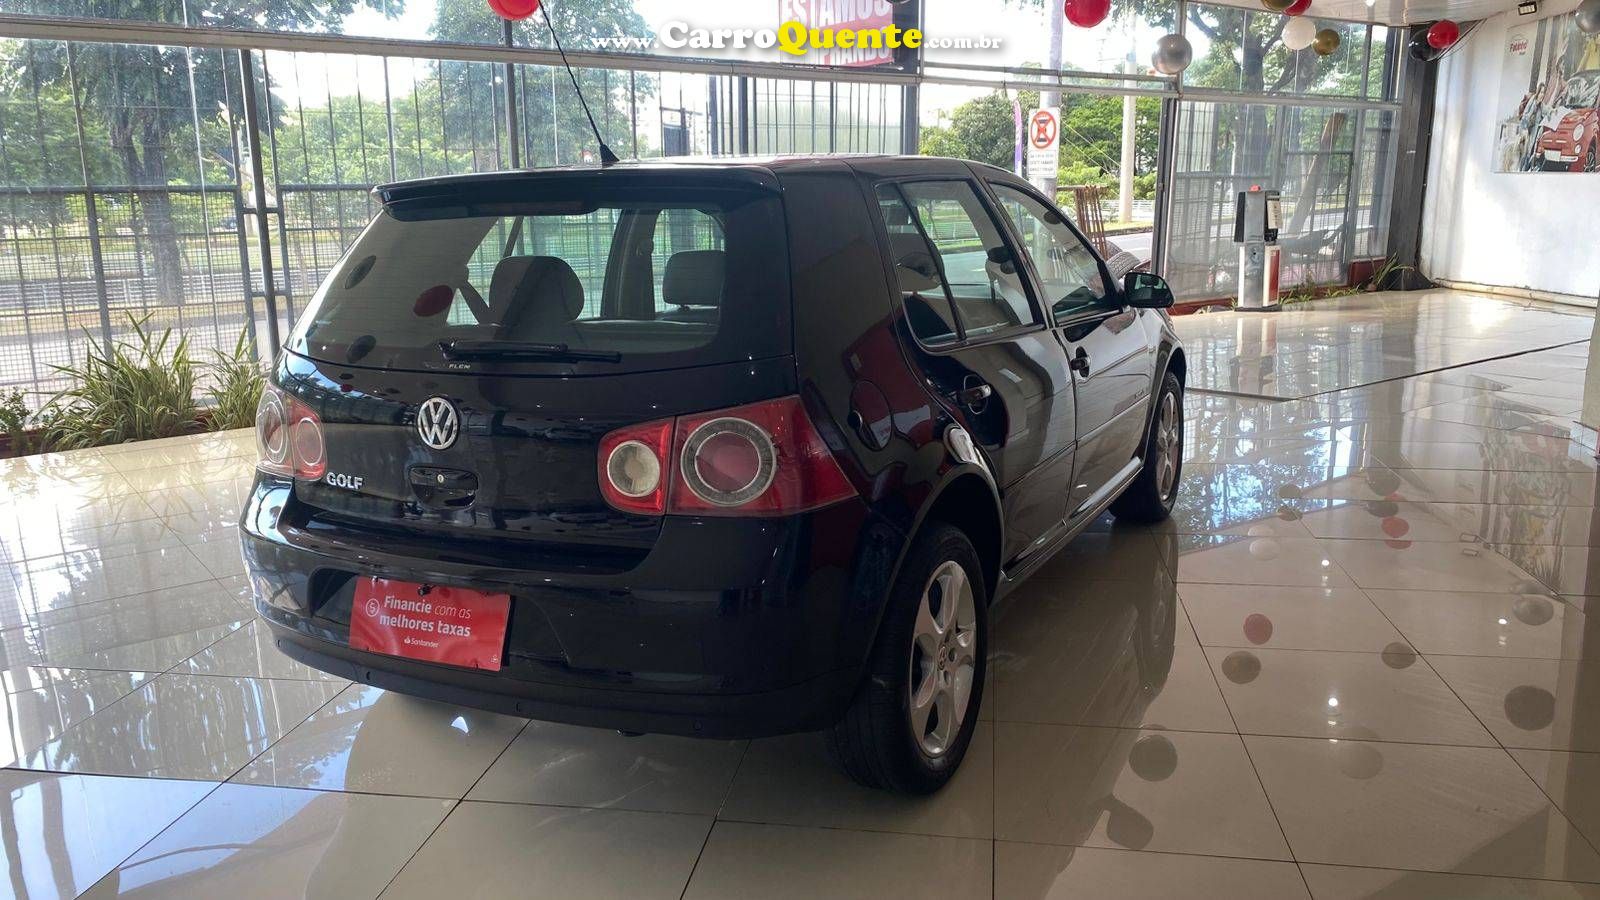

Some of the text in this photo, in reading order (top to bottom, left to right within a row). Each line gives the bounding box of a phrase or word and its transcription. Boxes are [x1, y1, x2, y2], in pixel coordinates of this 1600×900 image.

[326, 471, 363, 490] GOLF
[384, 595, 432, 614] Financie
[434, 604, 457, 617] com
[458, 607, 471, 619] as
[380, 614, 471, 637] melhores taxas
[411, 637, 439, 648] Santander
